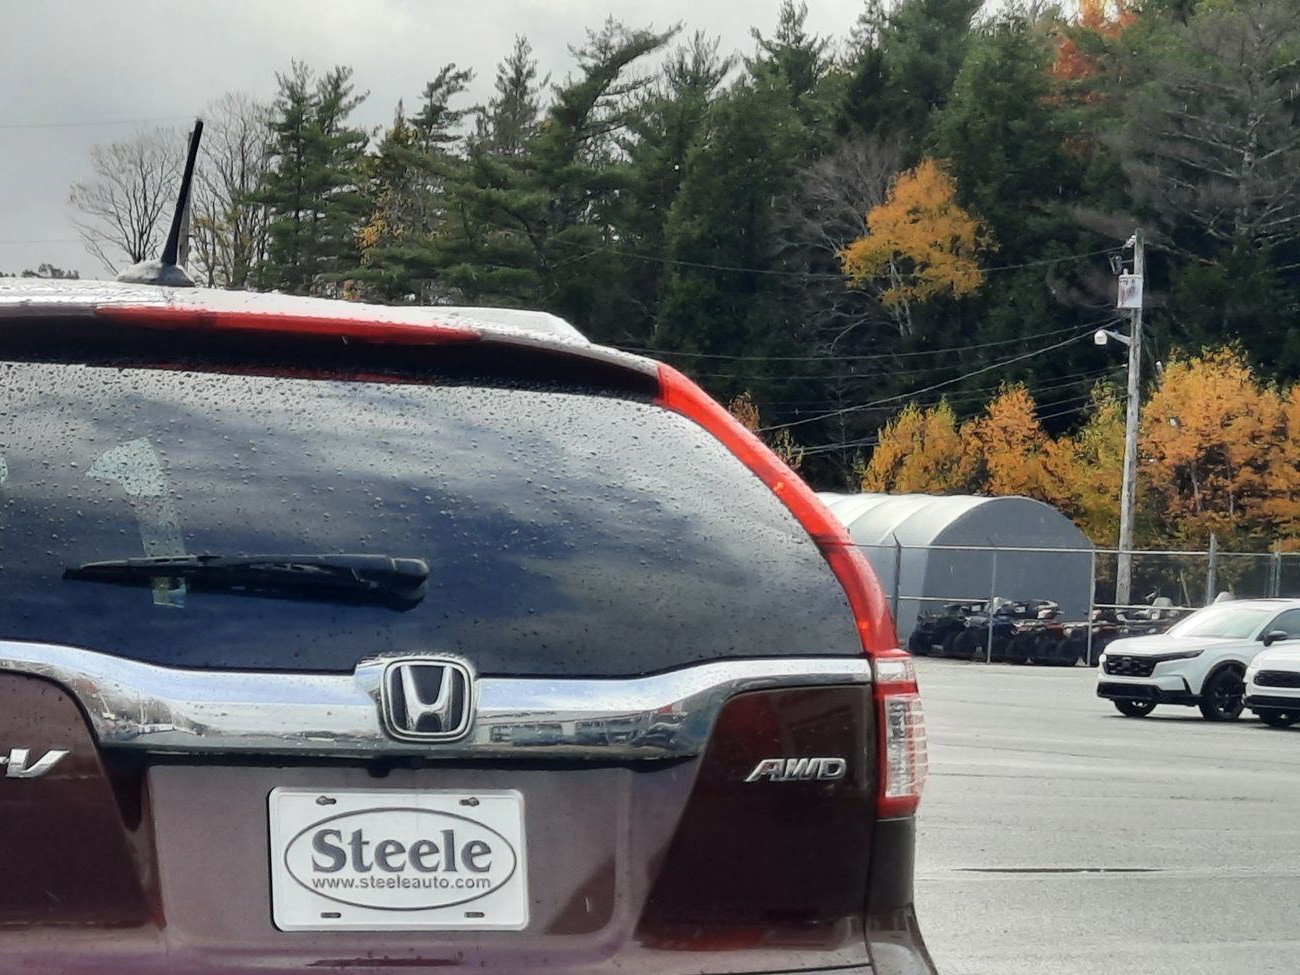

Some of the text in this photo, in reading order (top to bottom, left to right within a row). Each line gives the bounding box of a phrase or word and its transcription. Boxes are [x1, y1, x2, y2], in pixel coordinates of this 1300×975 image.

[743, 757, 847, 782] AWD
[311, 828, 493, 873] Steele
[312, 875, 492, 890] www.steeleauto.com
